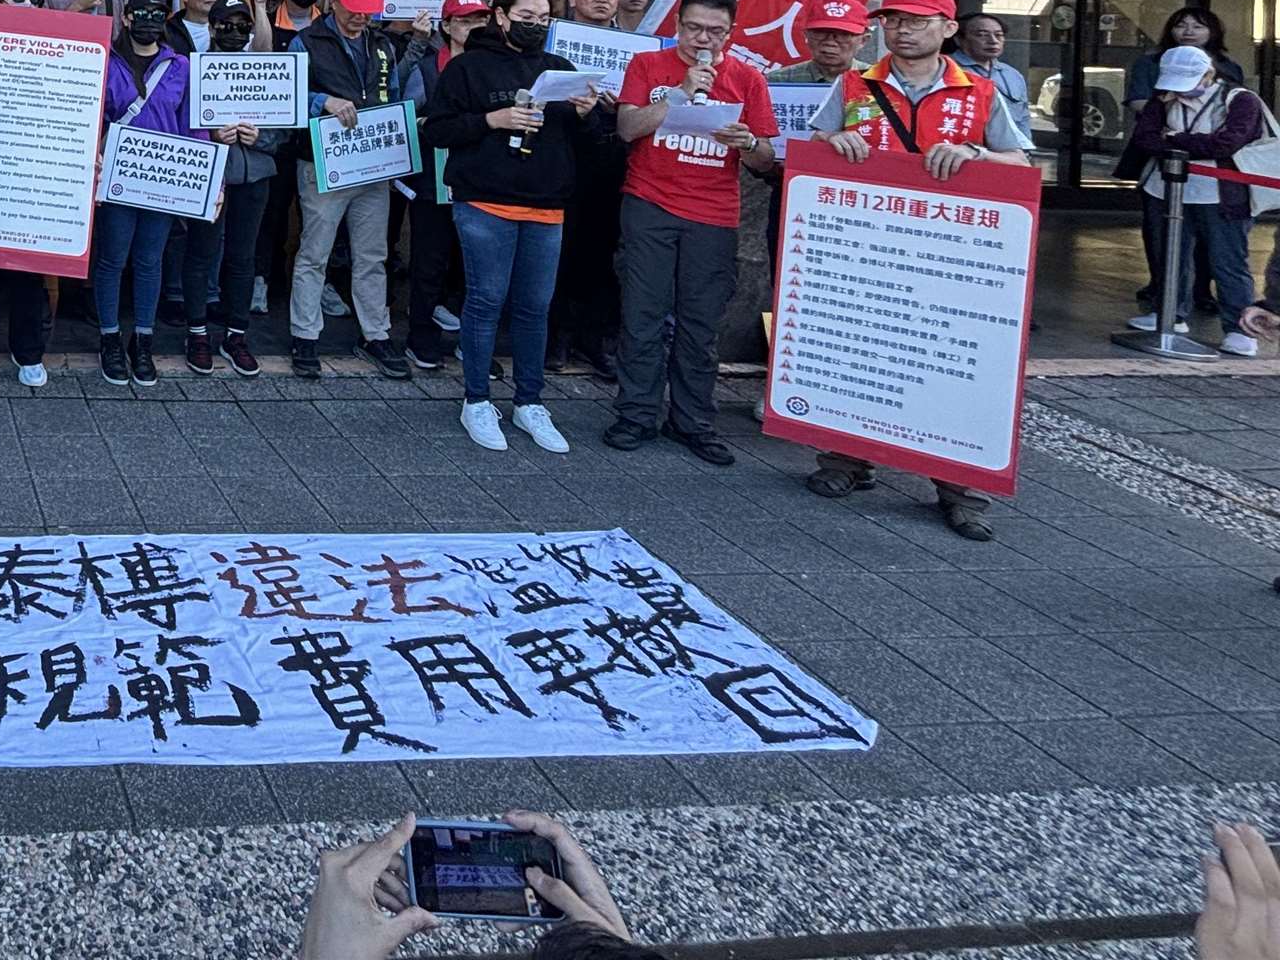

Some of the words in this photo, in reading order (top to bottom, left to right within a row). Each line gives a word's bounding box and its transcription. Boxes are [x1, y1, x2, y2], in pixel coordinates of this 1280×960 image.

[1, 44, 18, 53] OF
[20, 46, 65, 58] TAIDOC
[29, 39, 102, 55] VIOLATIONS
[202, 72, 220, 80] AY
[207, 62, 240, 70] ANG
[242, 62, 287, 70] DORM
[230, 85, 266, 93] HINDI
[938, 97, 963, 145] 羅美
[119, 145, 209, 169] PATAKARAN
[122, 137, 175, 153] AYUSIN
[176, 147, 209, 159] ANG
[116, 159, 177, 176] IGALANG
[178, 171, 208, 182] ANG
[118, 169, 202, 191] KARAPATAN
[816, 185, 1000, 230] 泰博12項重大違規
